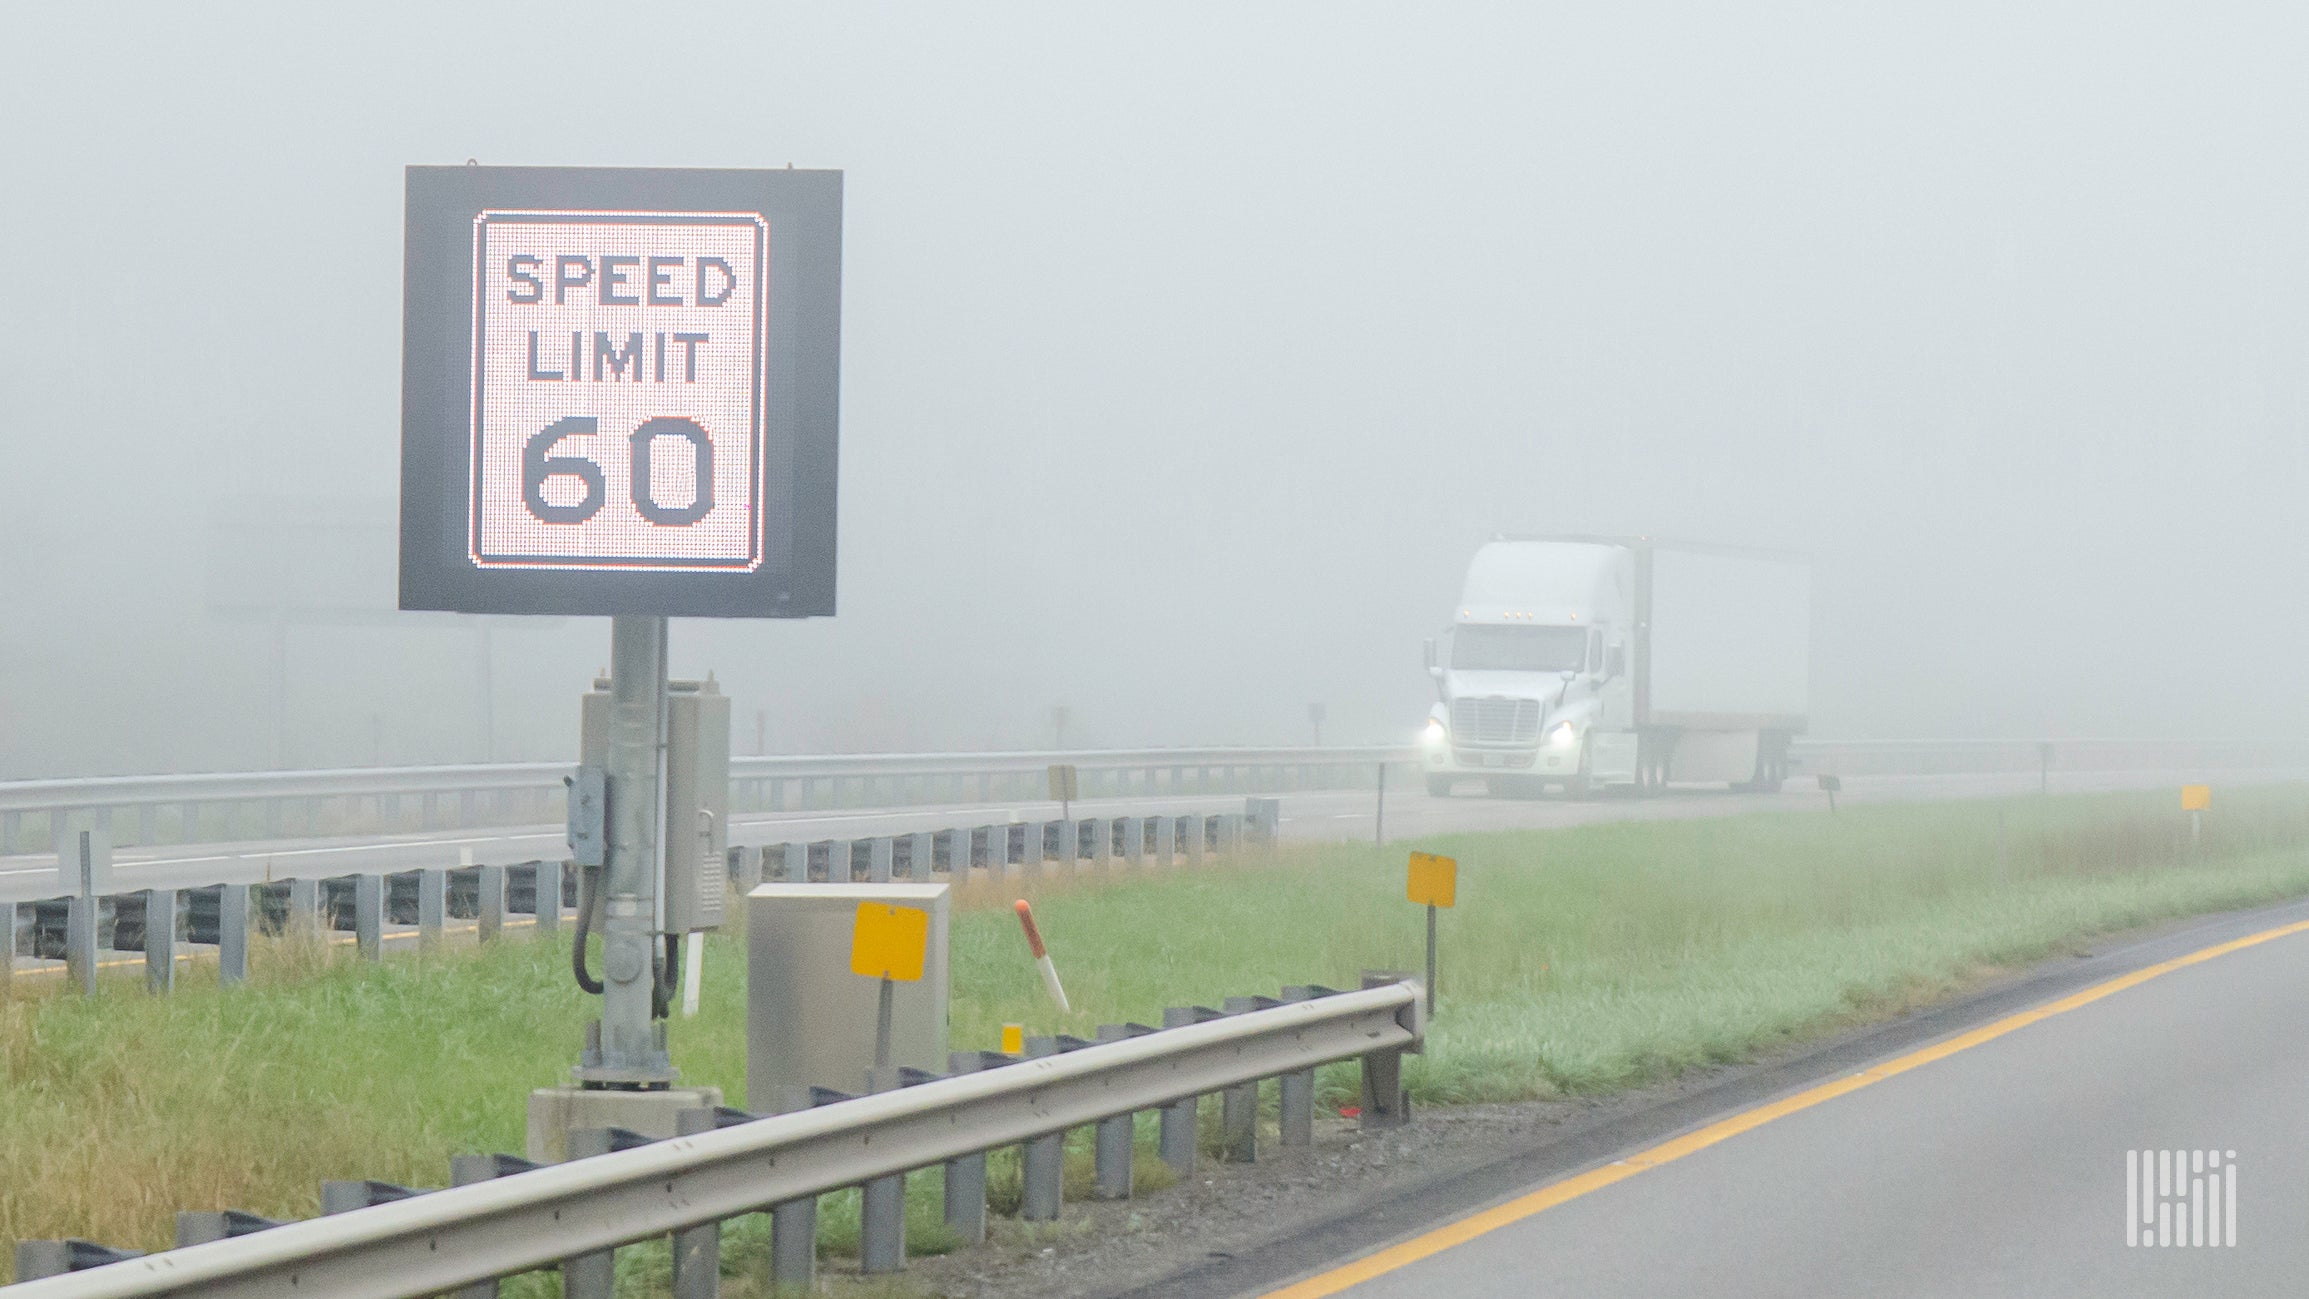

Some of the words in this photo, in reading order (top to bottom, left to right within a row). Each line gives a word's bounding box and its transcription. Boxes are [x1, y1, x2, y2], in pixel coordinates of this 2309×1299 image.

[507, 254, 737, 306] SPEED
[528, 331, 709, 383] LIMIT
[521, 416, 715, 527] 60
